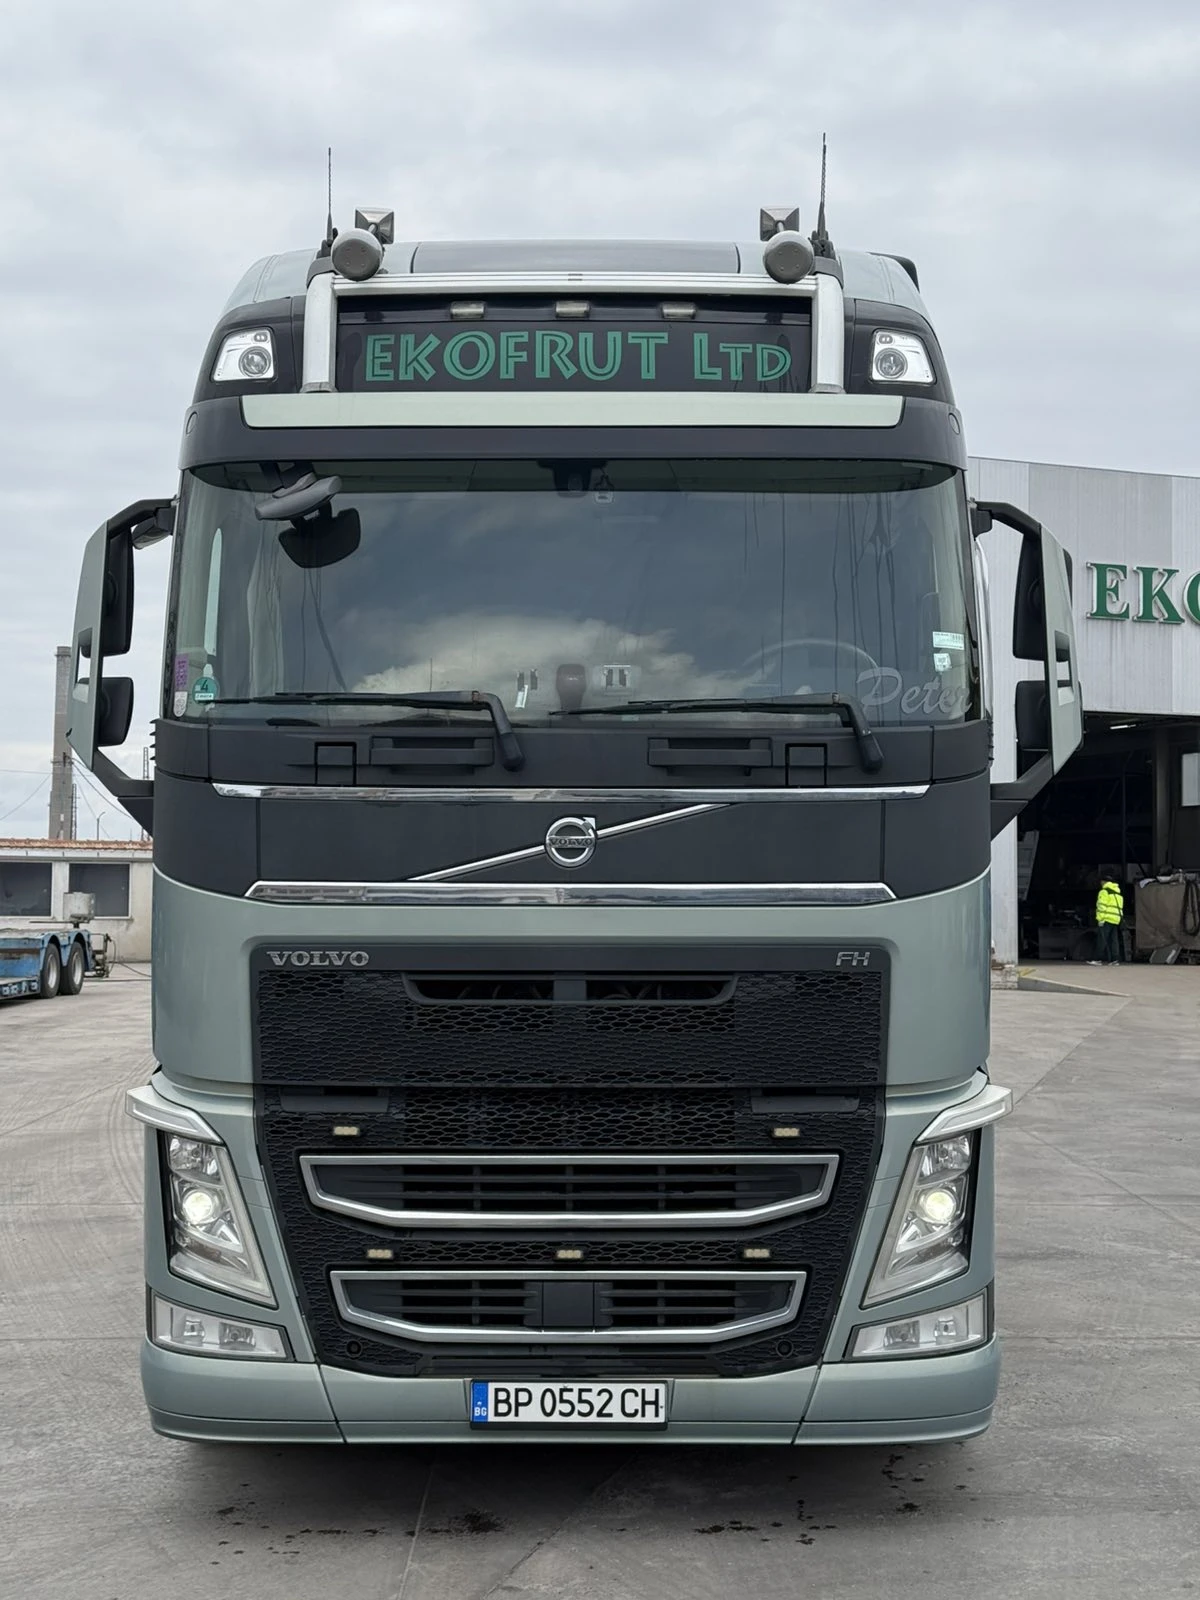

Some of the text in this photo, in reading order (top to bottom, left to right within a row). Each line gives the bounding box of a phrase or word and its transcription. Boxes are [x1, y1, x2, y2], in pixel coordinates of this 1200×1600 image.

[365, 330, 669, 382] EKOFRUT
[200, 679, 209, 693] 4
[548, 837, 594, 847] VOLVO
[266, 950, 370, 967] VOLVO
[835, 951, 871, 967] FH
[493, 1387, 660, 1418] BP 0552 CH
[474, 1406, 487, 1417] BG
